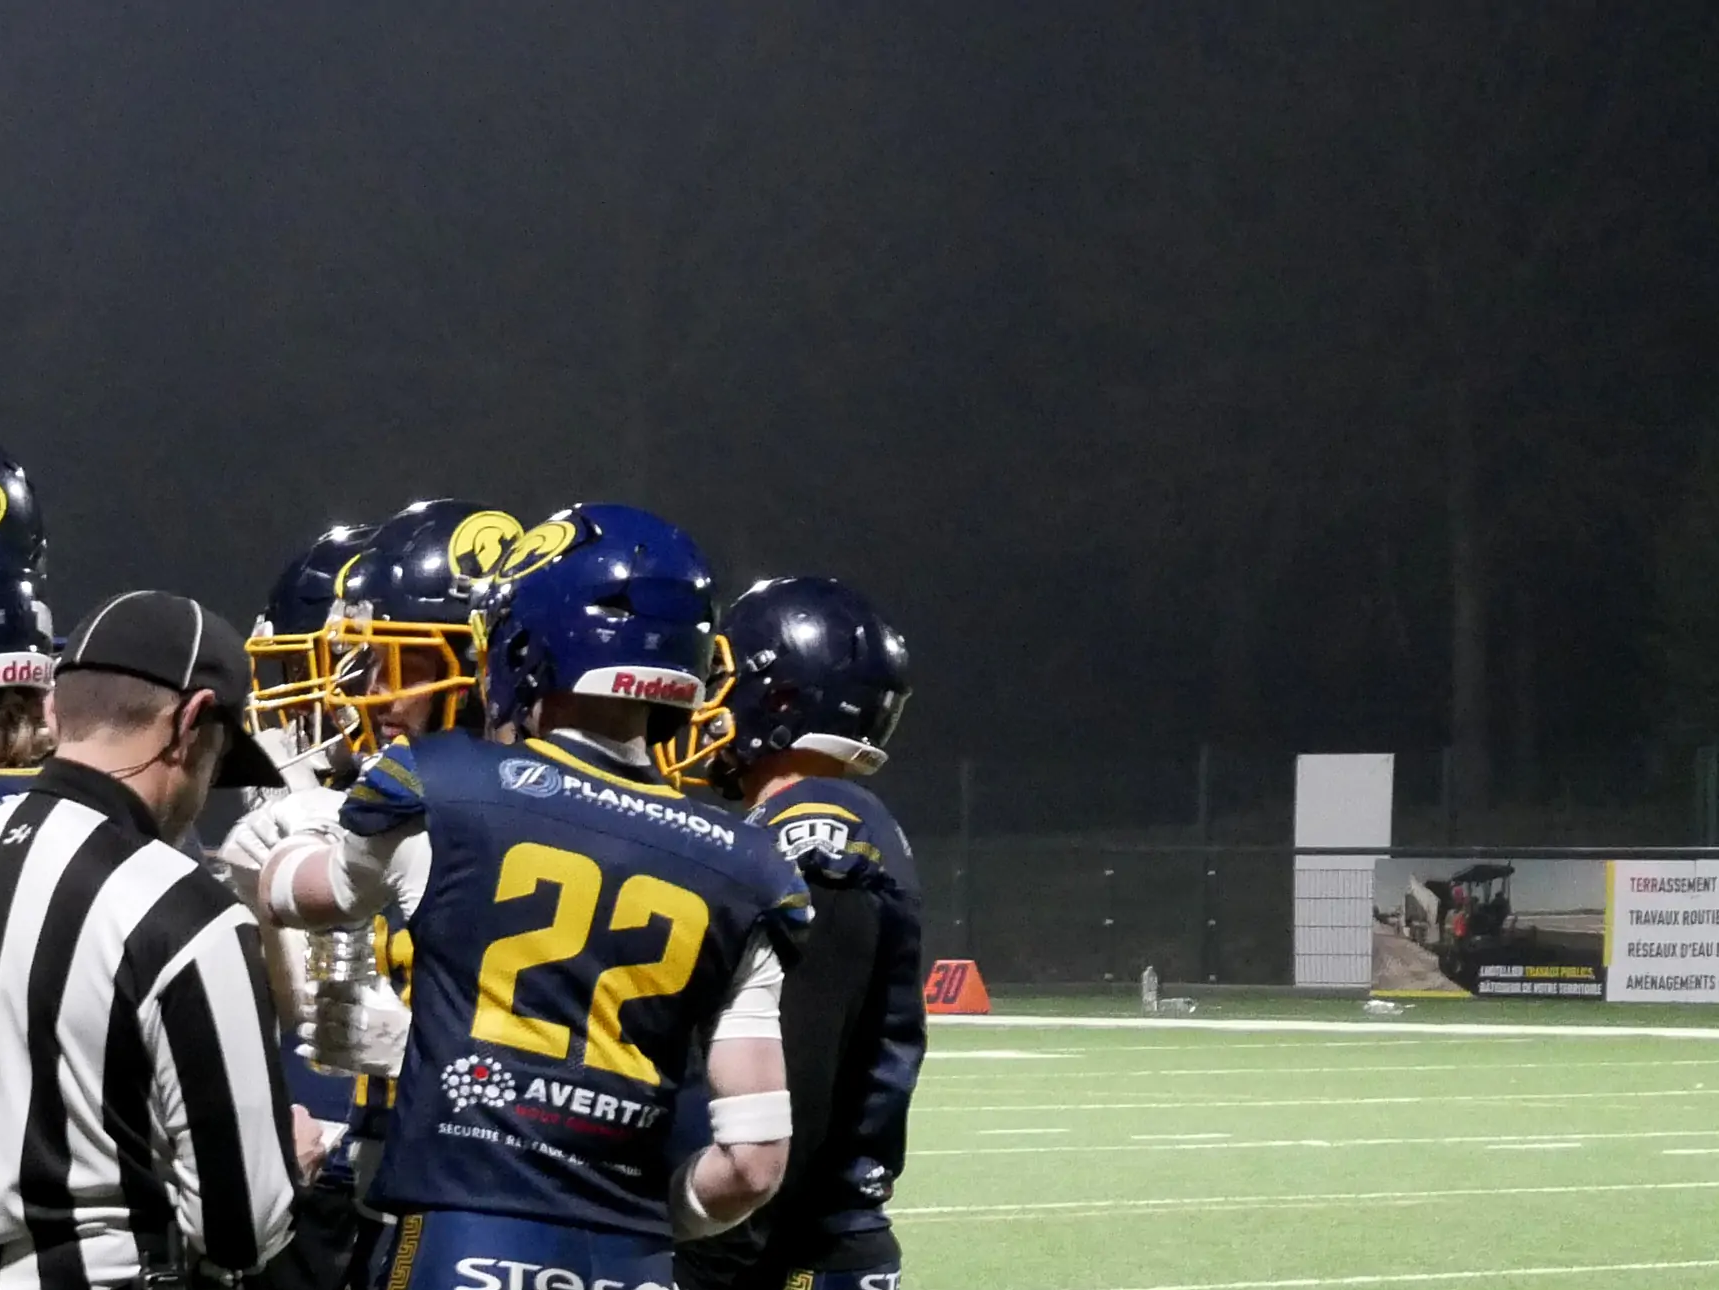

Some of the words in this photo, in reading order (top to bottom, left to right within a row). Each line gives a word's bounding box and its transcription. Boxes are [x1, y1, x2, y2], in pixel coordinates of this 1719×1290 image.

[562, 774, 736, 846] PLANCHON
[785, 821, 846, 848] CIT
[1628, 908, 1681, 927] TRAVAUX
[470, 841, 710, 1086] 22
[925, 963, 970, 1005] 30
